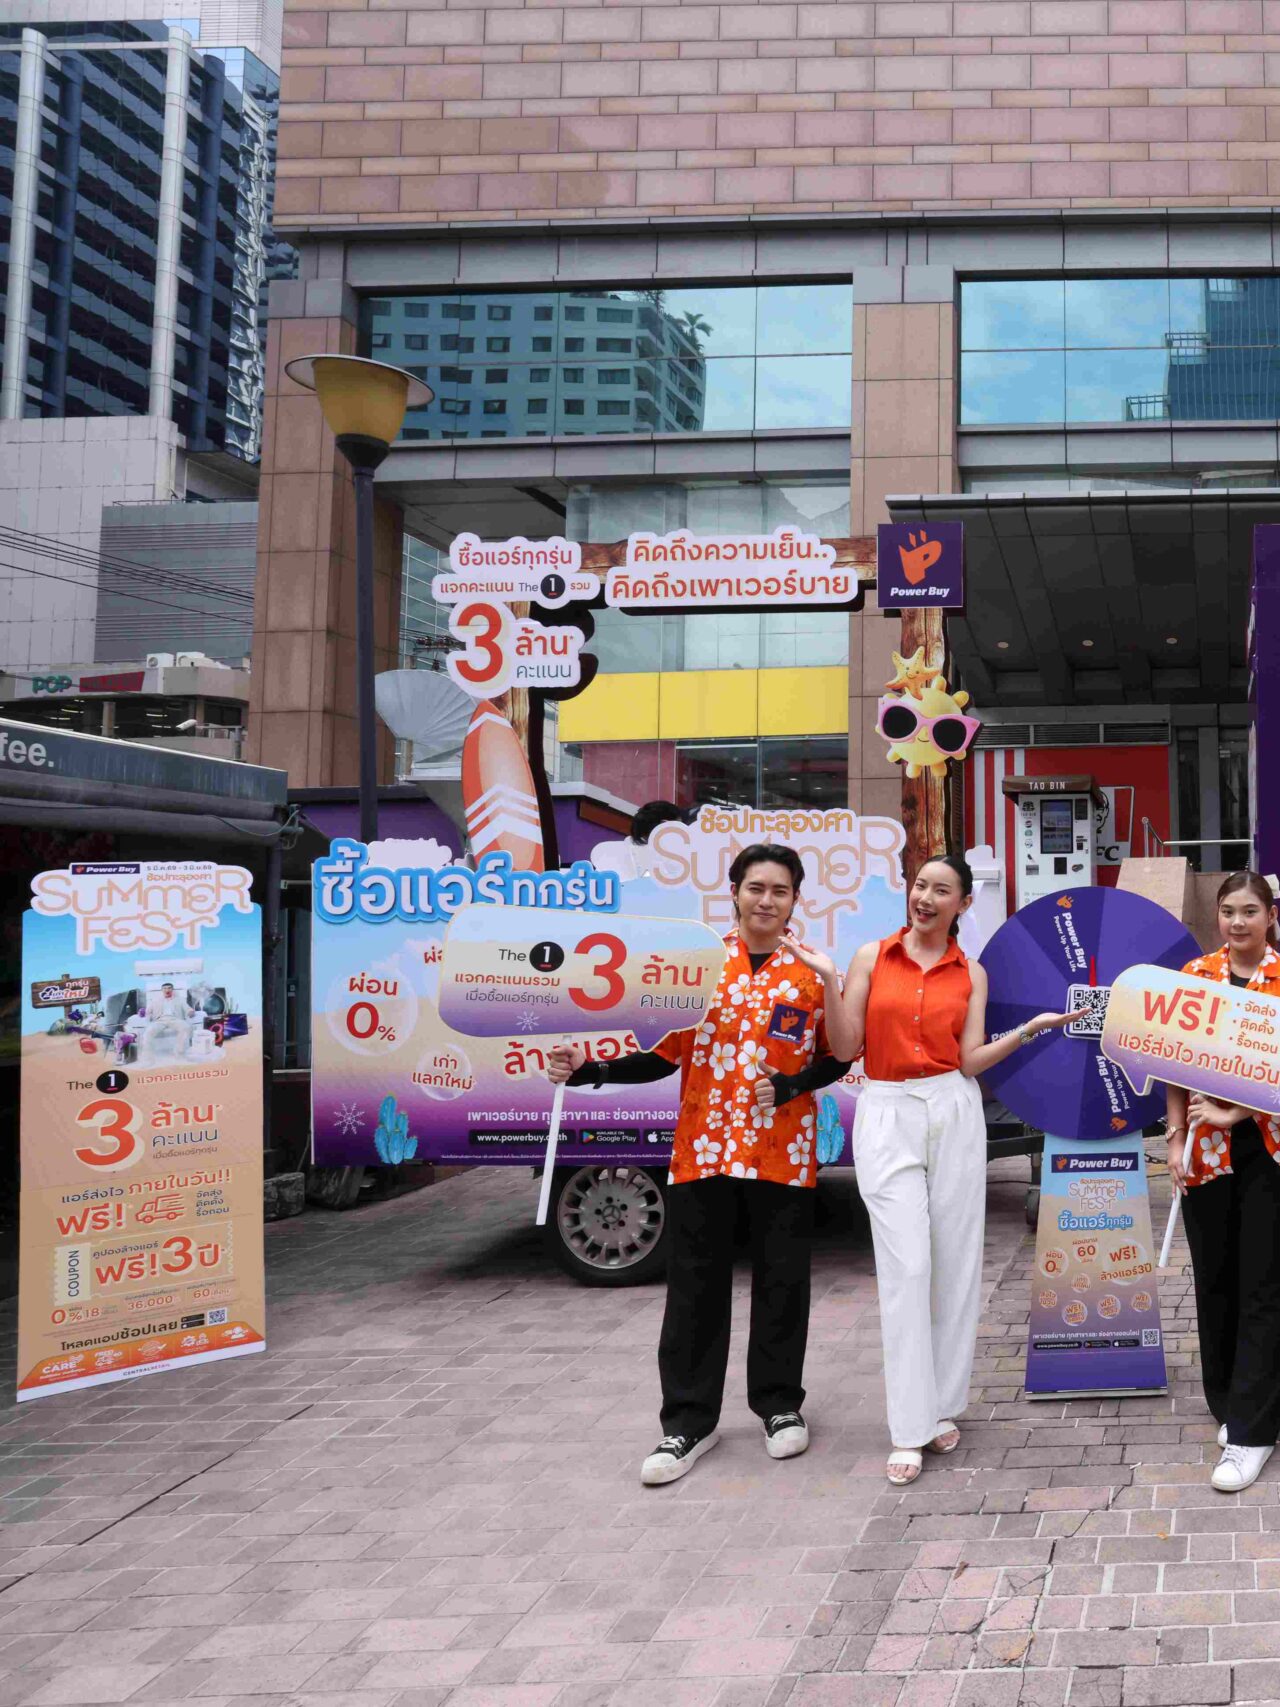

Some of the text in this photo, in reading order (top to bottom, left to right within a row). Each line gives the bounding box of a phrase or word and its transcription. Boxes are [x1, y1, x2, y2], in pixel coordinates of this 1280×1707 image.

[458, 540, 573, 570] ซื้อแอร์ทุกรุ่น
[633, 533, 828, 563] คิดถึงความเย็น..
[440, 580, 514, 595] แจกคะแนน
[519, 582, 540, 592] The
[570, 581, 591, 591] รวม
[612, 570, 850, 600] คิดถึงเพาเวอร์บาย
[890, 586, 950, 598] Power Buy
[455, 603, 503, 683] 3
[516, 664, 572, 680] คะแนน
[33, 675, 72, 693] POP
[1029, 781, 1065, 790] TAO BIN
[700, 808, 853, 840] ช้อปทะลุองศา
[86, 865, 137, 874] Power Buy
[82, 910, 214, 951] FEST
[1053, 915, 1064, 934] Power
[1060, 935, 1067, 945] Up
[1064, 945, 1072, 960] Your
[1062, 912, 1088, 969] Power Buy
[499, 949, 527, 962] The
[455, 971, 561, 987] แจกคะแนนรวม
[568, 932, 628, 1012] 3
[349, 972, 398, 996] ผ่อน
[465, 988, 560, 1006] เมื่อซื้อแอร์ทุกรุ่น
[640, 993, 705, 1011] คะแนน
[1143, 988, 1220, 1036] ฟรี!
[1244, 1001, 1277, 1017] จัดส่ง
[346, 1001, 396, 1041] 0%
[1240, 1019, 1275, 1035] ติดตั้ง
[1118, 1032, 1194, 1063] แอร์ส่งไว
[1237, 1034, 1278, 1054] รื้อถอน
[433, 1054, 458, 1070] เก่า
[67, 1068, 229, 1091] The แจกคะแนนรวม
[412, 1072, 473, 1090] แลกใหม่
[1096, 1055, 1121, 1113] Power Buy
[1116, 1079, 1123, 1089] Up
[1120, 1089, 1130, 1109] Power
[467, 1108, 611, 1122] เพาเวอร์บาย และ
[74, 1098, 136, 1166] 3
[152, 1128, 218, 1148] คะแนน
[597, 1135, 637, 1143] Google Play
[1069, 1157, 1134, 1169] Power Buy
[61, 1168, 231, 1204] แอร์ส่งไว ภายในวัน!!
[56, 1202, 123, 1237] ฟรี!
[1060, 1211, 1132, 1230] ซื้อแอร์ทุกรุ่น
[95, 1252, 157, 1285] ฟรี!
[162, 1236, 193, 1273] 3
[1077, 1245, 1096, 1257] 60
[1109, 1245, 1137, 1262] ฟรี!
[68, 1249, 80, 1297] COUPON
[193, 1288, 210, 1299] 60
[43, 1362, 77, 1374] CARE
